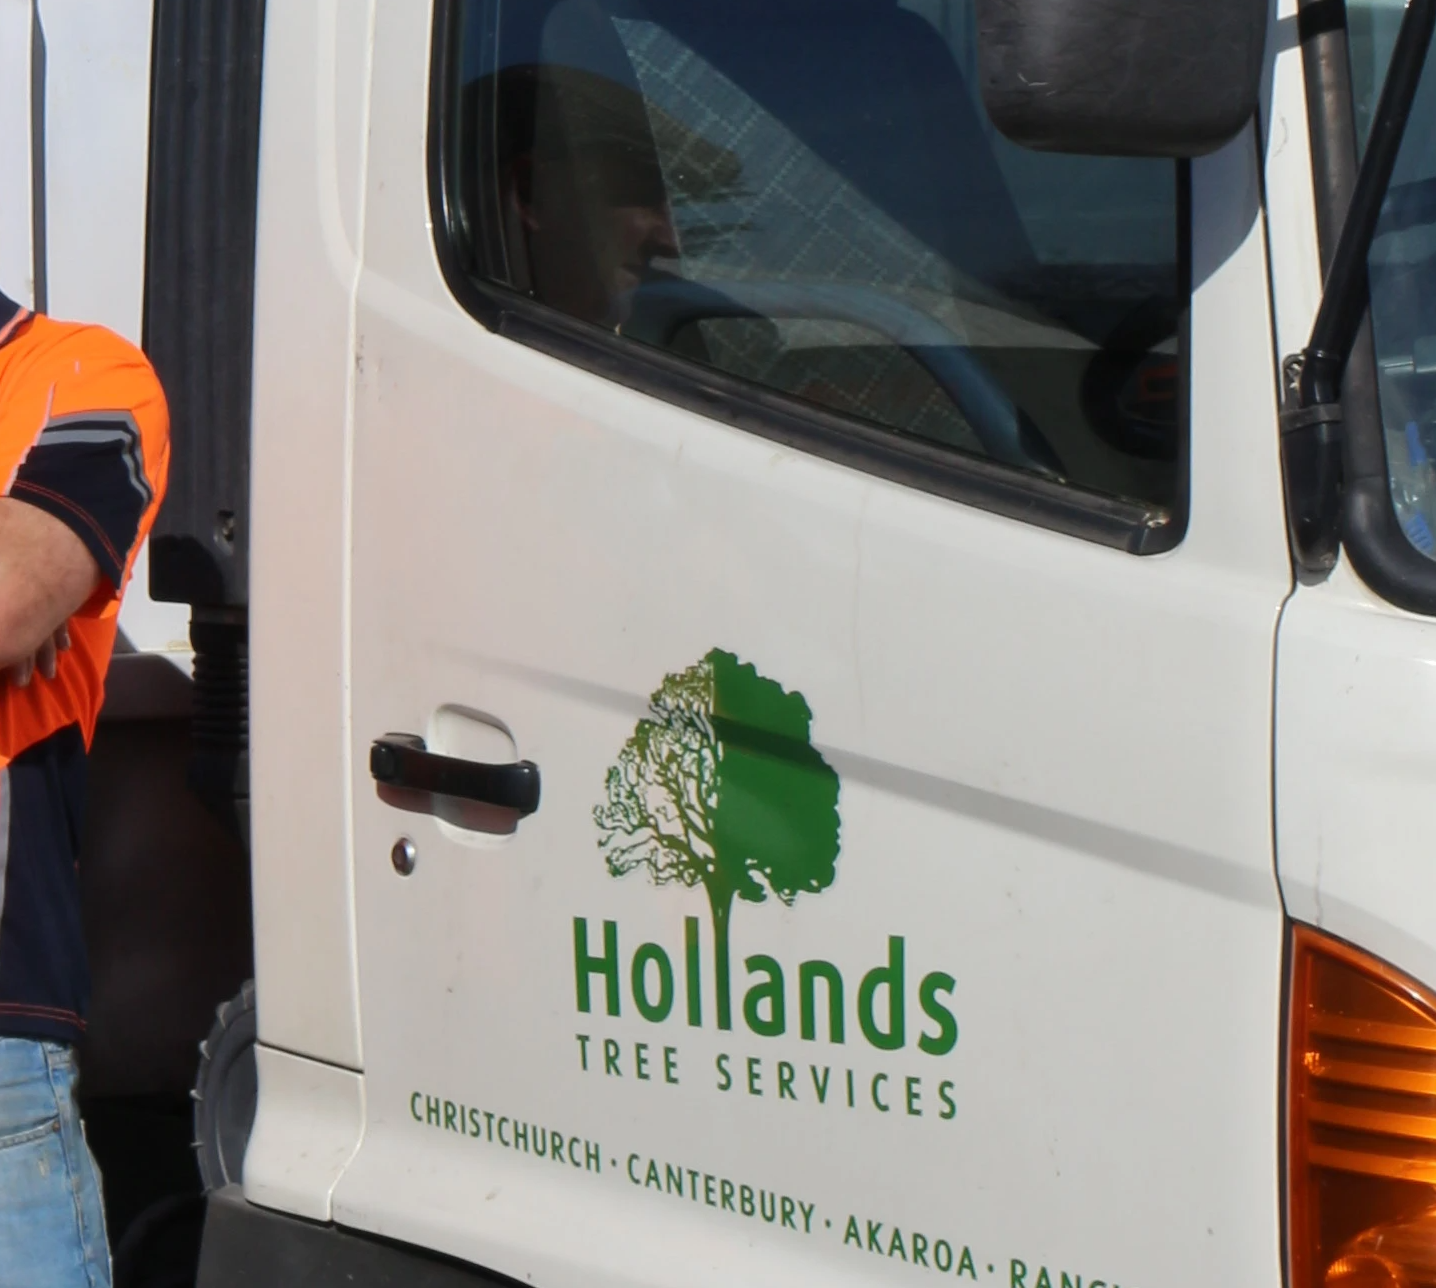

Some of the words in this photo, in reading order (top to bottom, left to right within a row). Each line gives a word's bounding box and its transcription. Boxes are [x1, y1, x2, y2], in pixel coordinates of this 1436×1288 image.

[572, 915, 960, 1057] Hollands
[575, 1033, 680, 1085] TREE
[715, 1052, 958, 1121] SERVICES
[410, 1090, 602, 1174] CHRISTCHURCH
[627, 1152, 816, 1234] CANTERBURY
[843, 1214, 978, 1282] AKAROA
